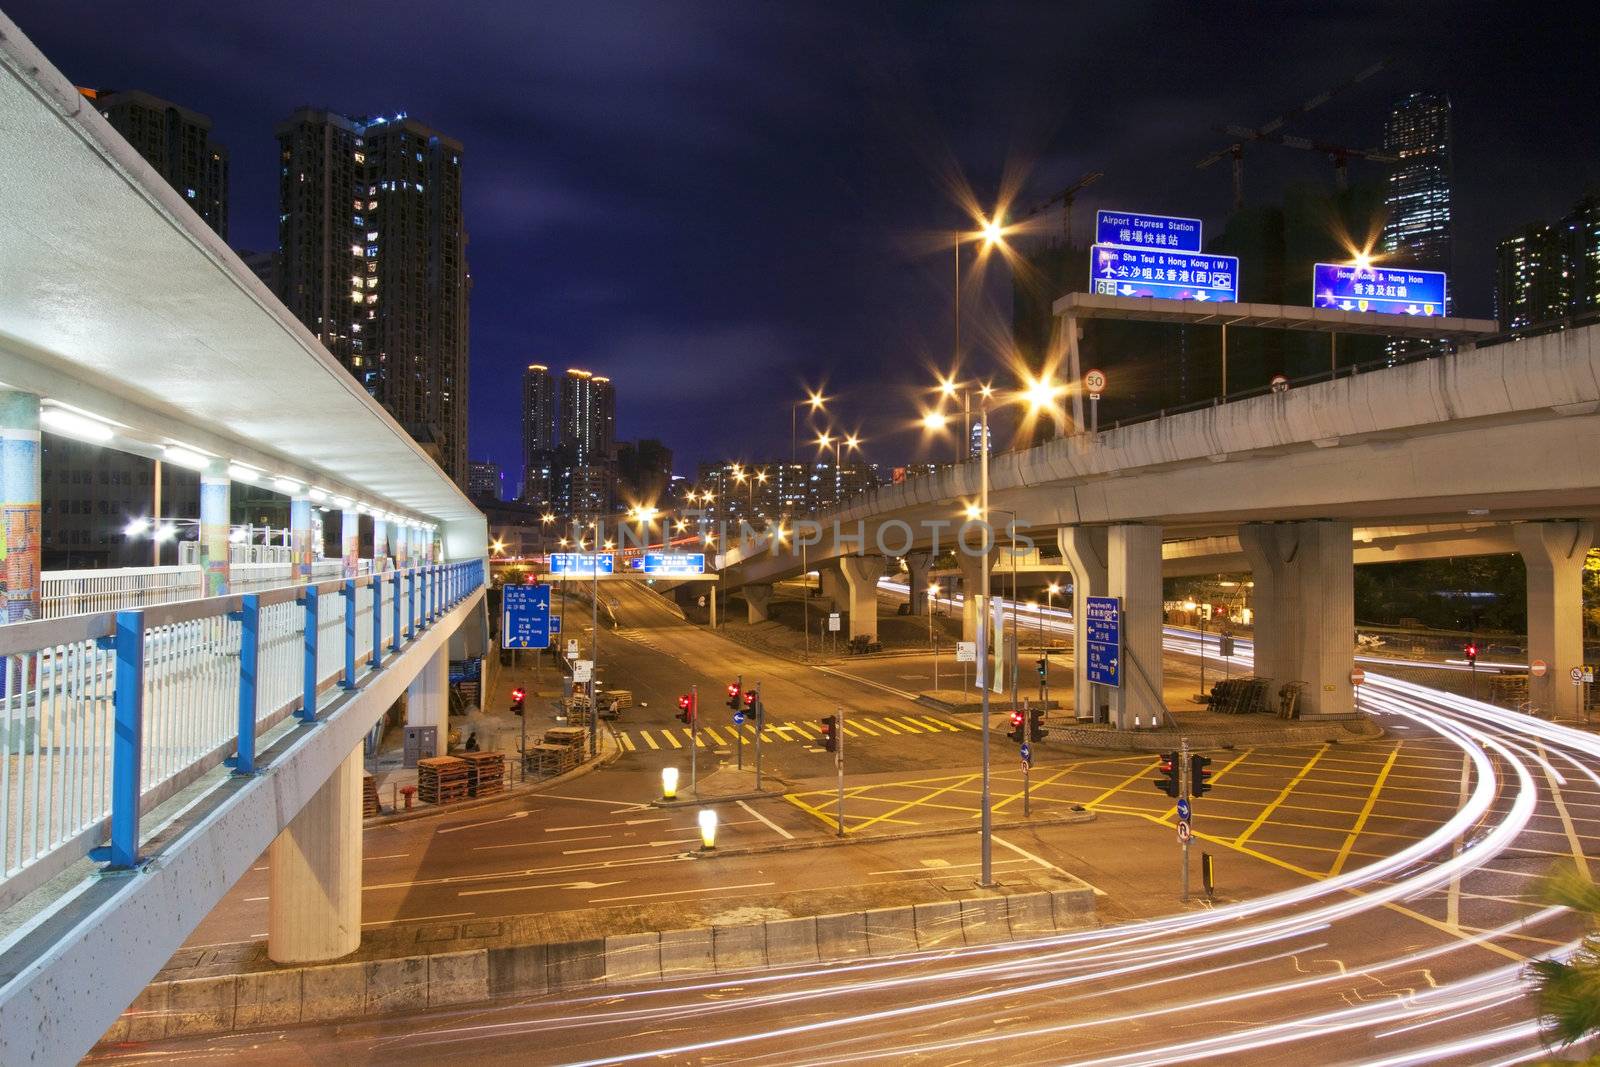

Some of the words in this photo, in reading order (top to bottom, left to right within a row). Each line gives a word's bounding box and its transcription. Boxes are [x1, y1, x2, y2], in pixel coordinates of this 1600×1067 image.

[1102, 215, 1129, 227] Airport
[1134, 218, 1164, 230] Express
[1168, 221, 1194, 232] Station
[1123, 252, 1136, 262] Sha
[1140, 254, 1155, 264] Tsui
[1158, 256, 1164, 265] &
[1168, 257, 1186, 268] Hong
[1190, 258, 1209, 270] Kong
[1212, 260, 1229, 271] (W)
[1337, 269, 1354, 281] Hong
[1378, 273, 1384, 281] &
[1388, 274, 1405, 284] Hung
[1408, 275, 1424, 285] Hom
[1097, 282, 1115, 295] 6E
[1087, 376, 1103, 387] 50
